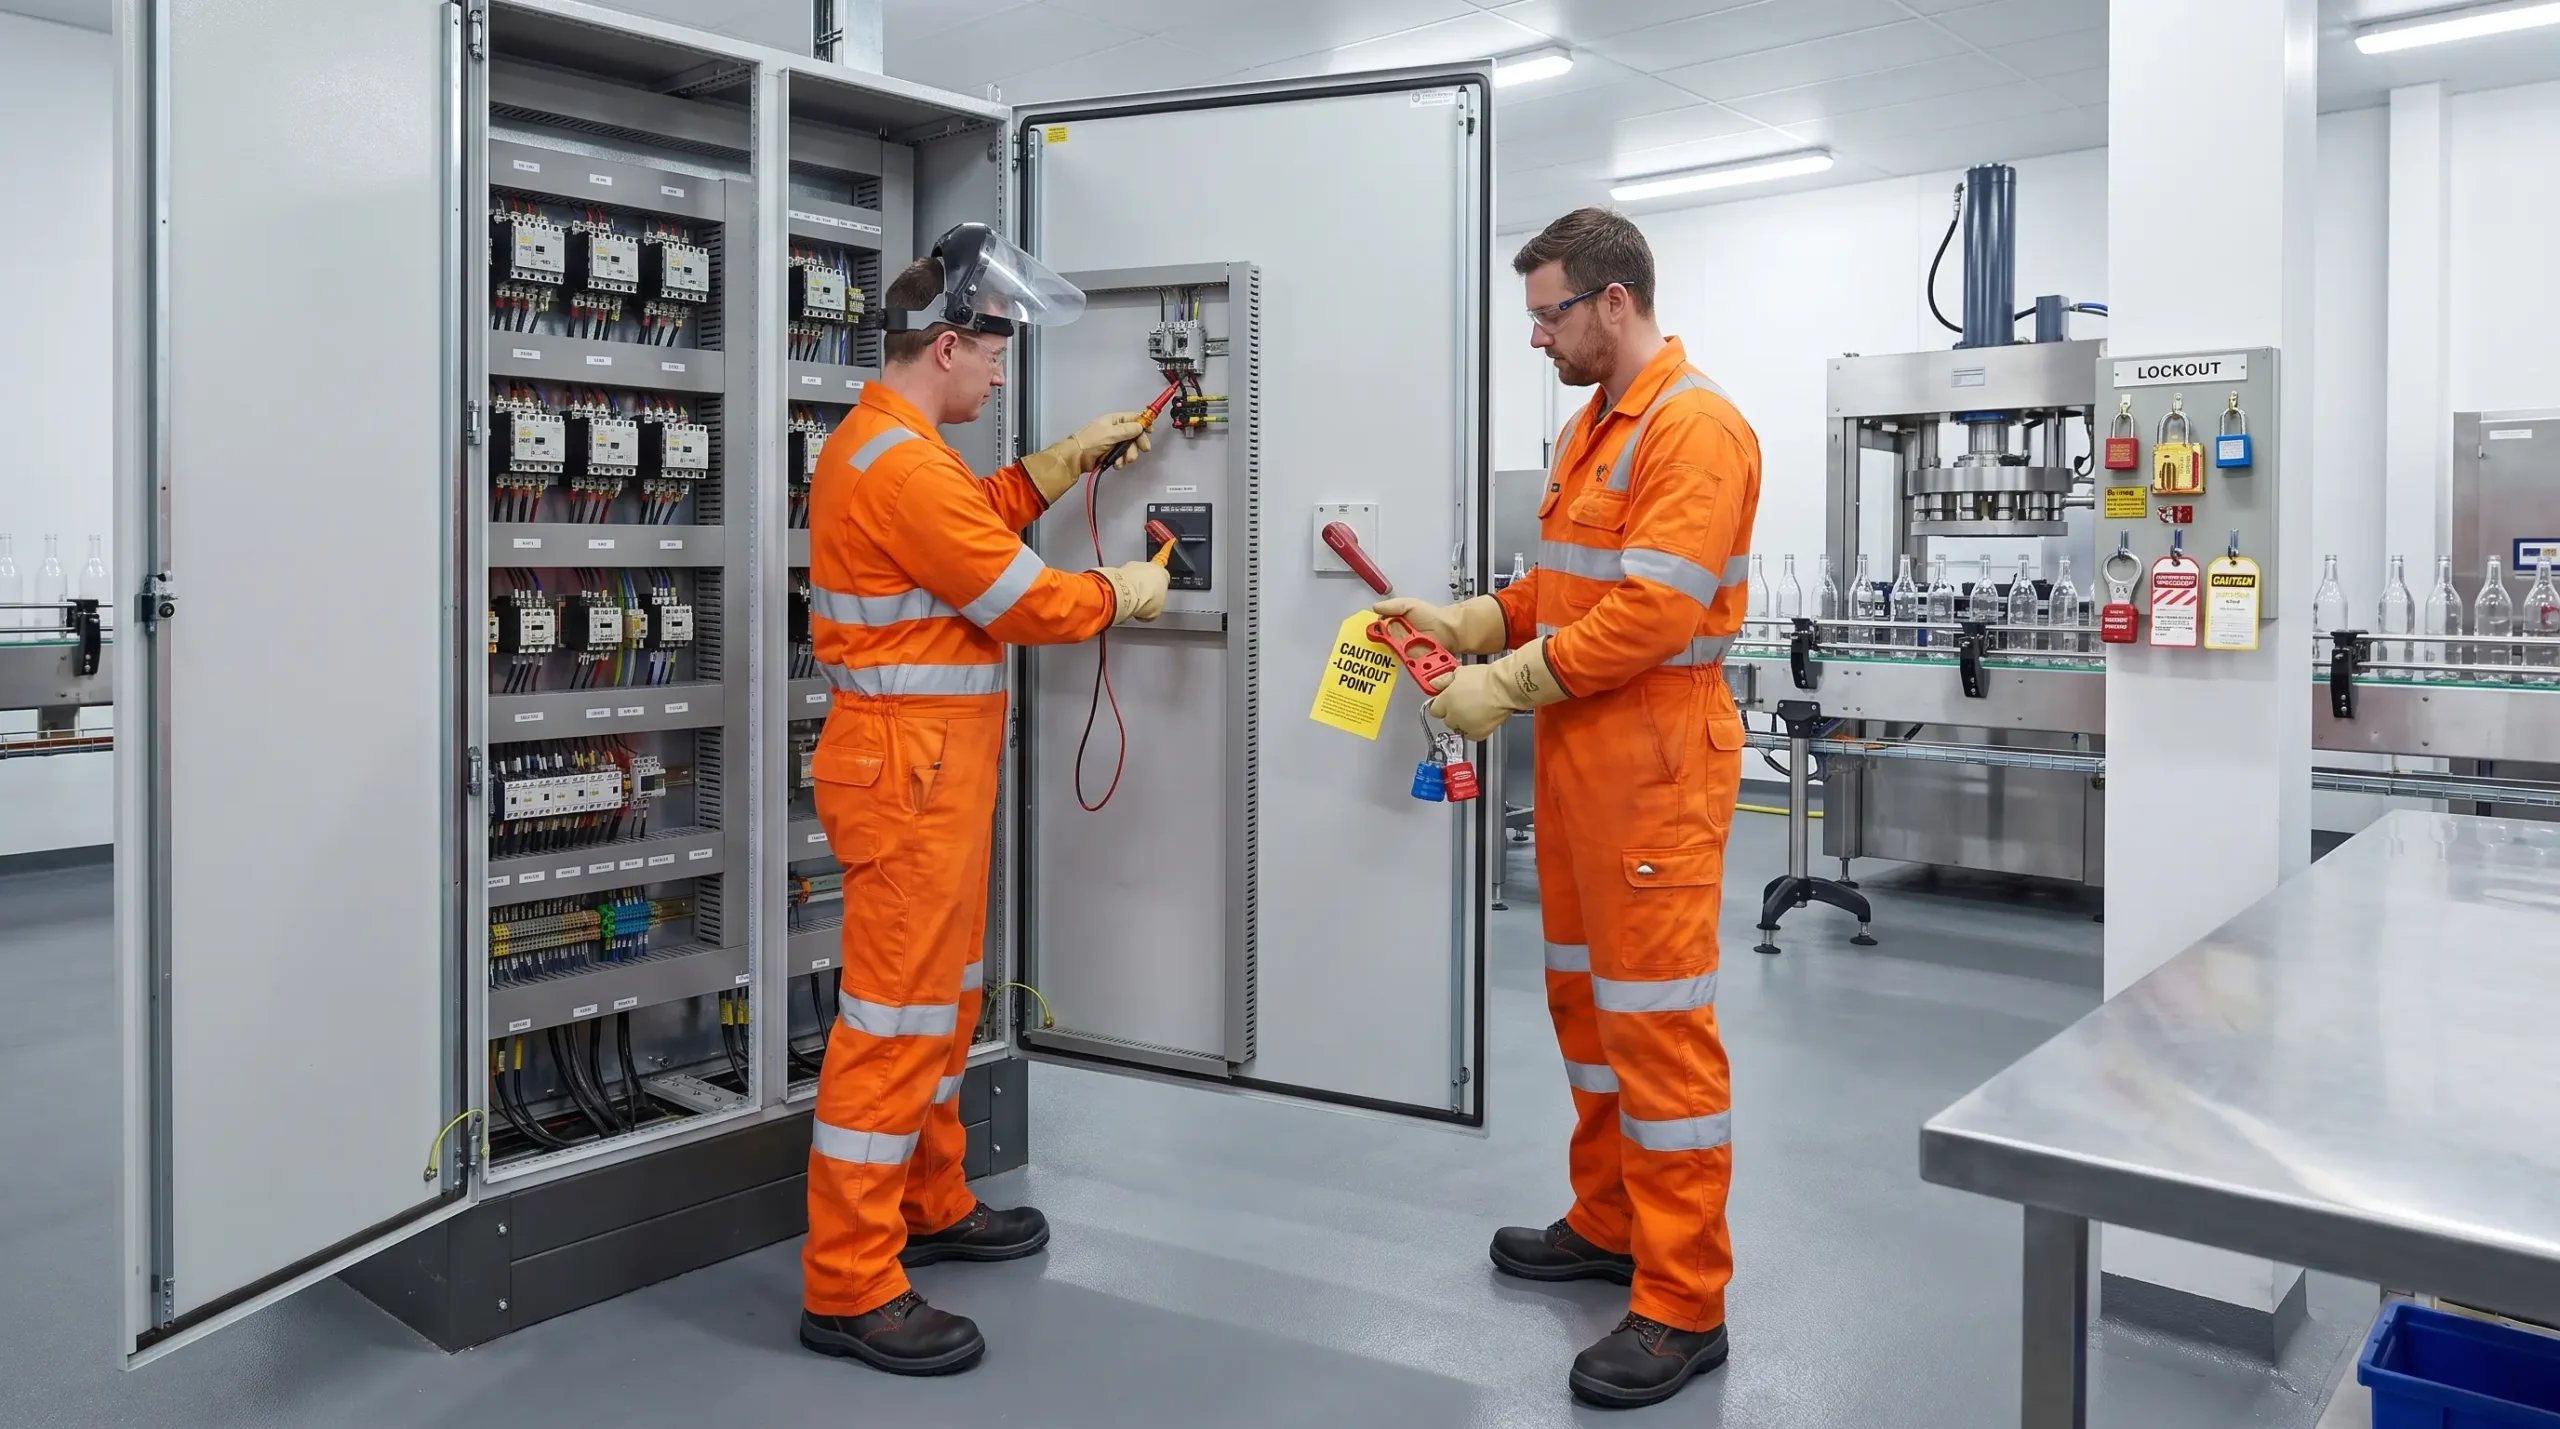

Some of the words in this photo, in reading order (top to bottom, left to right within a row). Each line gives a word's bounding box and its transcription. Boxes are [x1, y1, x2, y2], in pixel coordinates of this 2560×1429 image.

[2138, 361, 2222, 379] LOCKOUT
[1340, 642, 1396, 669] CAUTION-
[1333, 657, 1392, 684] -LOCKOUT
[1338, 673, 1377, 695] POINT
